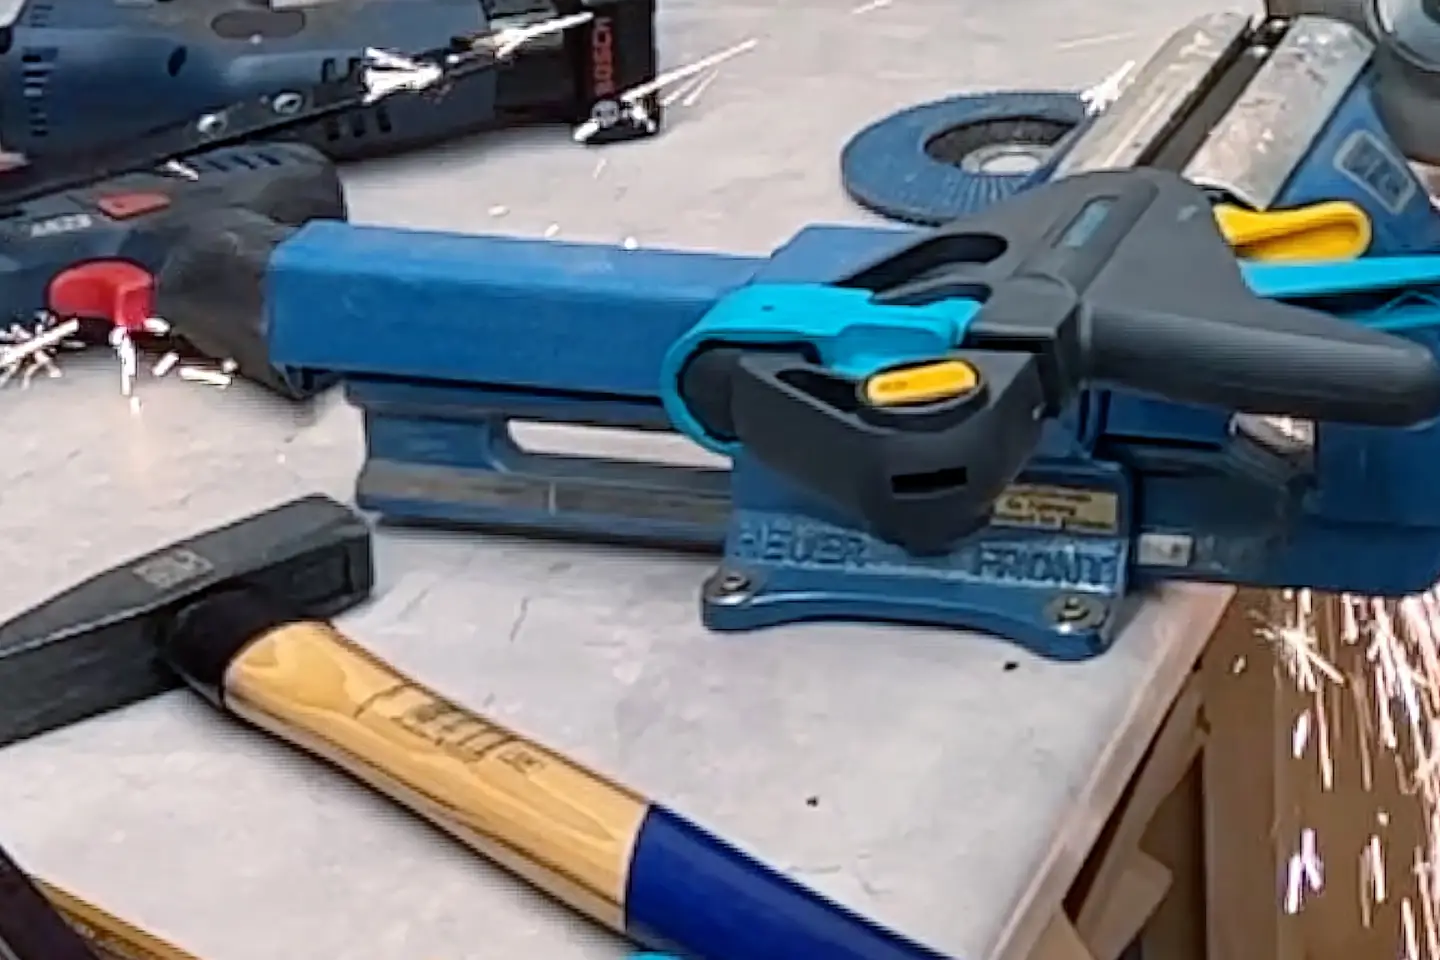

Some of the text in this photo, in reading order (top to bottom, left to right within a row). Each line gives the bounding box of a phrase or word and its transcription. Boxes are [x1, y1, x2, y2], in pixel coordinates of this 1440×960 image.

[592, 17, 616, 97] BOSCH
[735, 523, 867, 568] HEUER
[972, 544, 1118, 585] FRONT
